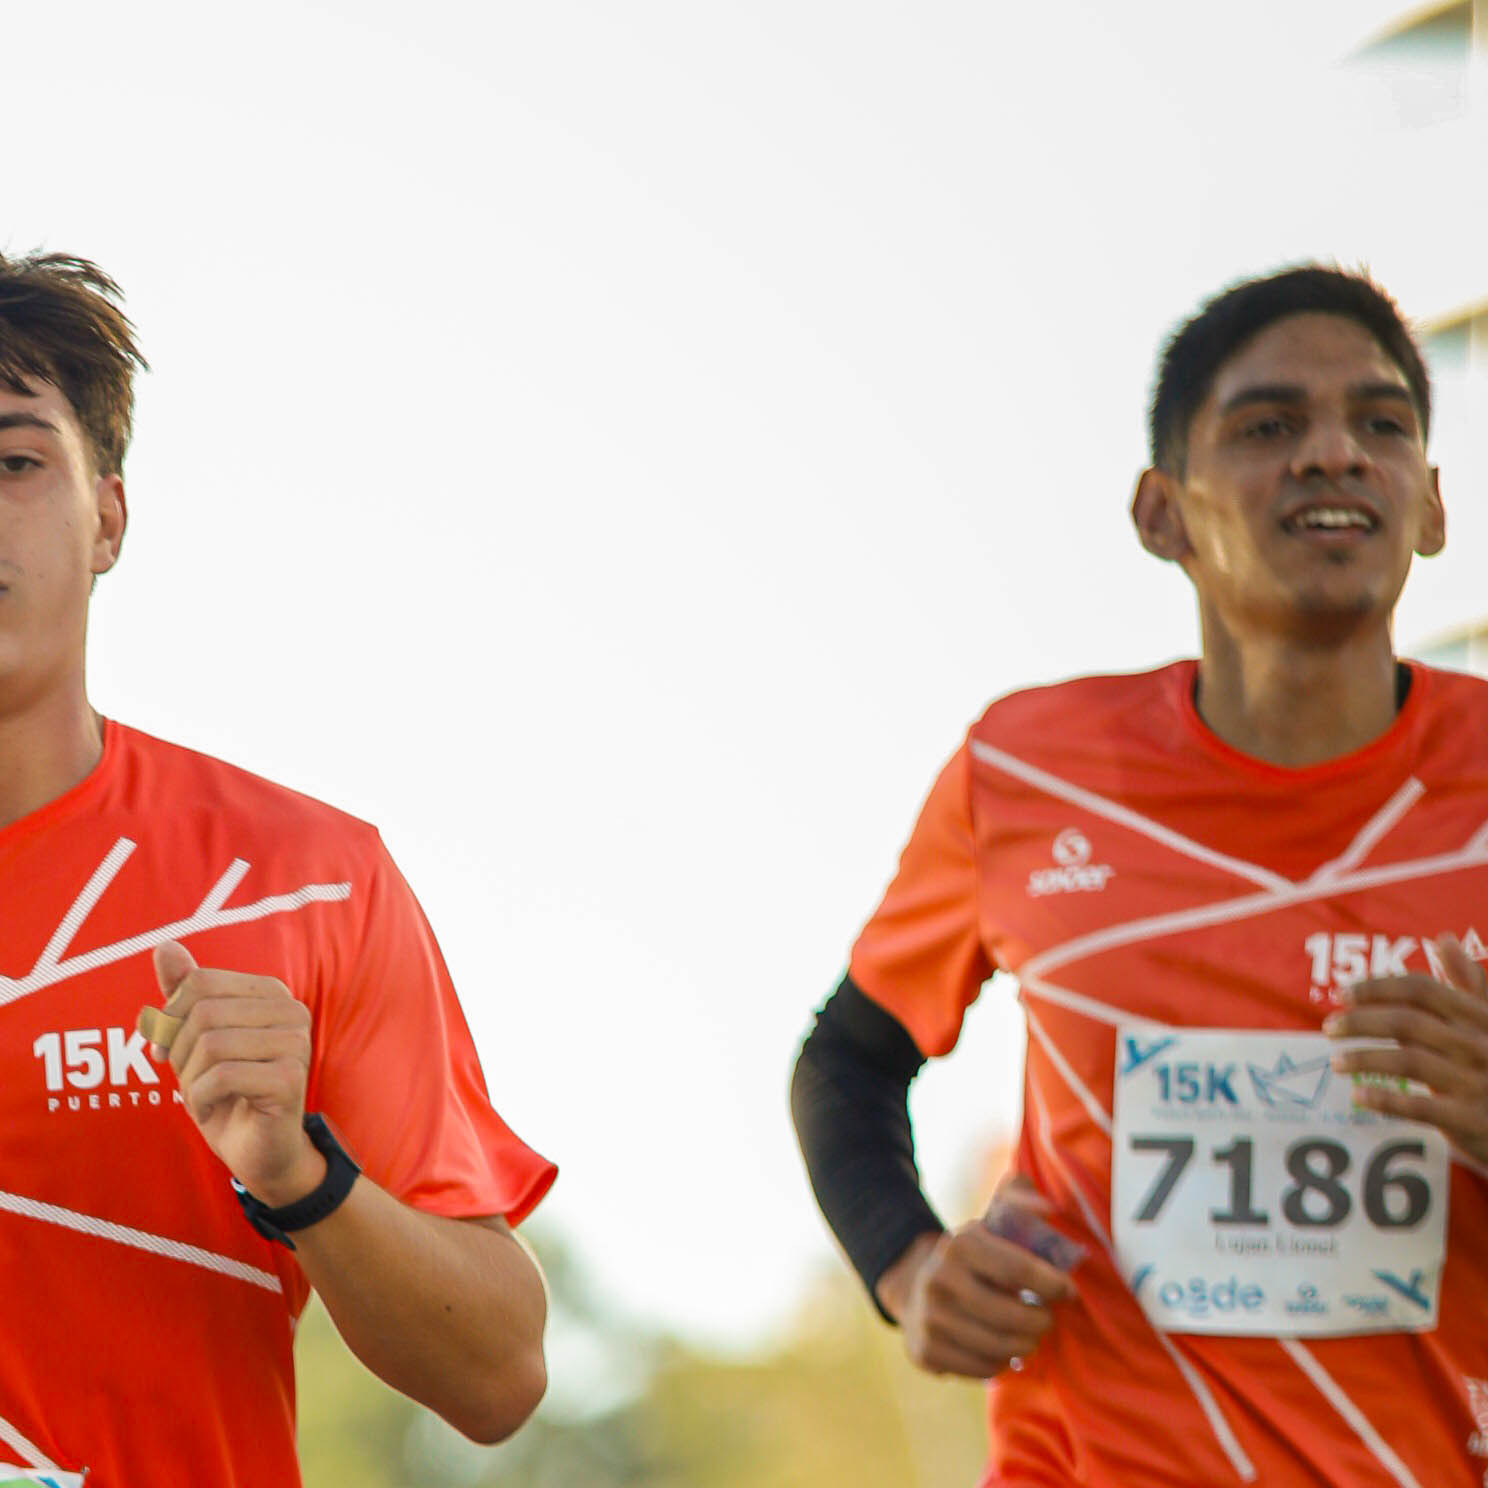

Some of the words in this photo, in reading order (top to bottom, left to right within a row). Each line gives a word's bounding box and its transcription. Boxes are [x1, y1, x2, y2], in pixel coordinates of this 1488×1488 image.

[1304, 931, 1418, 988] 15K
[33, 1027, 160, 1091] 15K
[1155, 1062, 1239, 1105] 15K
[48, 1090, 161, 1112] PUERTO
[1127, 1133, 1432, 1230] 7186
